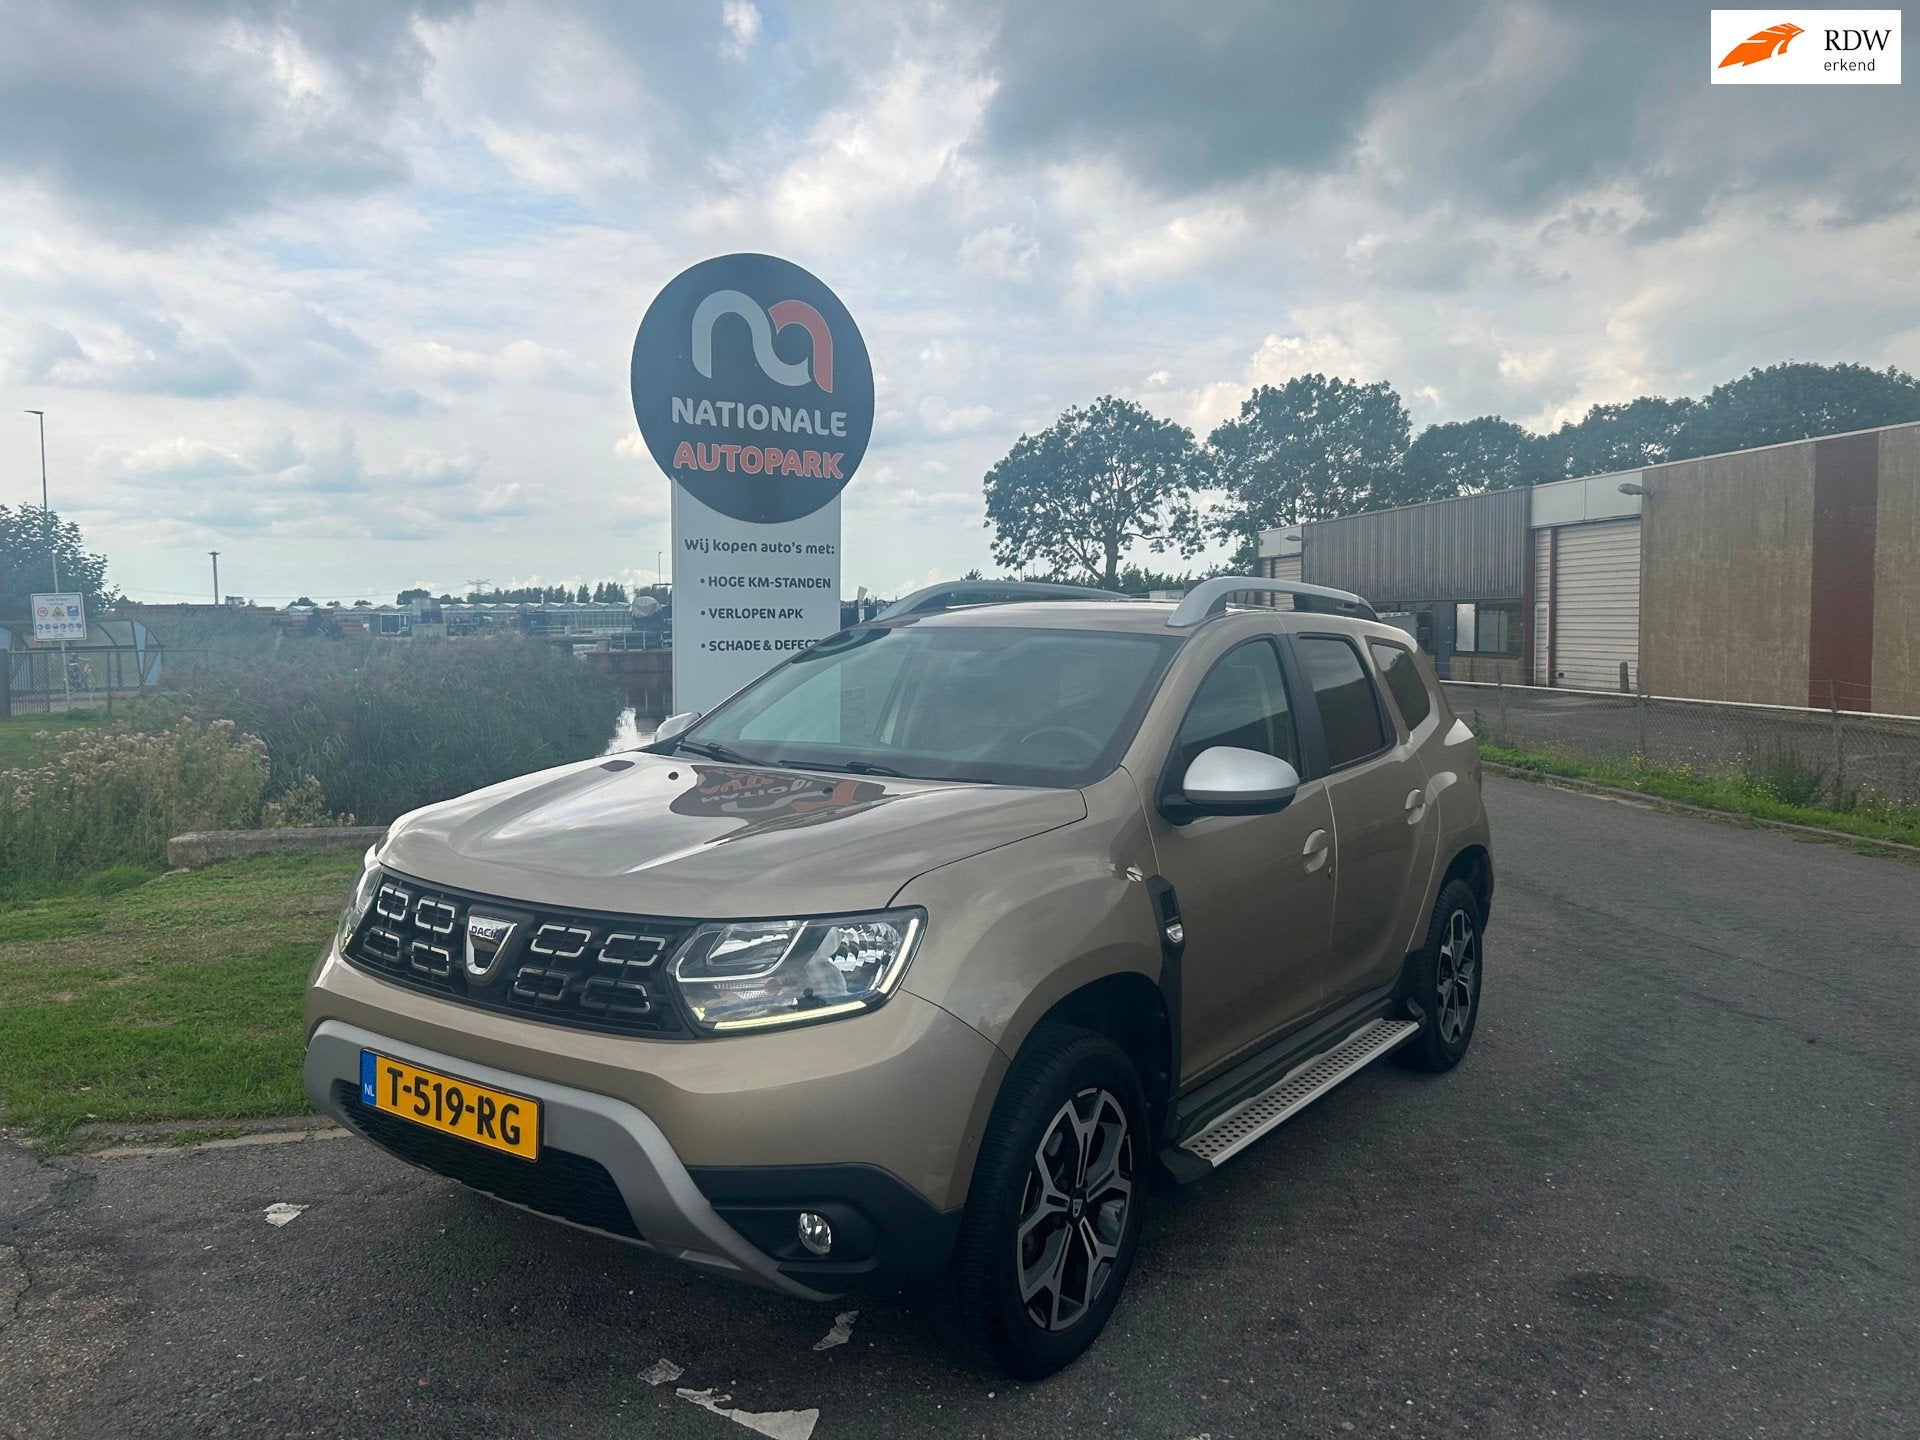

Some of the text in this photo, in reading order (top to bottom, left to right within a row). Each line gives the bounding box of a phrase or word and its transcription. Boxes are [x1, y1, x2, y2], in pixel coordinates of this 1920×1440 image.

[671, 396, 847, 437] NATIONALE
[673, 441, 845, 479] AUTOPARK
[684, 538, 835, 555] Wij kopen auto's met:
[708, 576, 831, 588] HOGE KM-STANDEN
[709, 608, 804, 619] VERLOPEN APK
[709, 640, 760, 651] SCHADE
[763, 640, 772, 651] &
[364, 1083, 375, 1097] NL
[386, 1066, 521, 1145] T-519-RG
